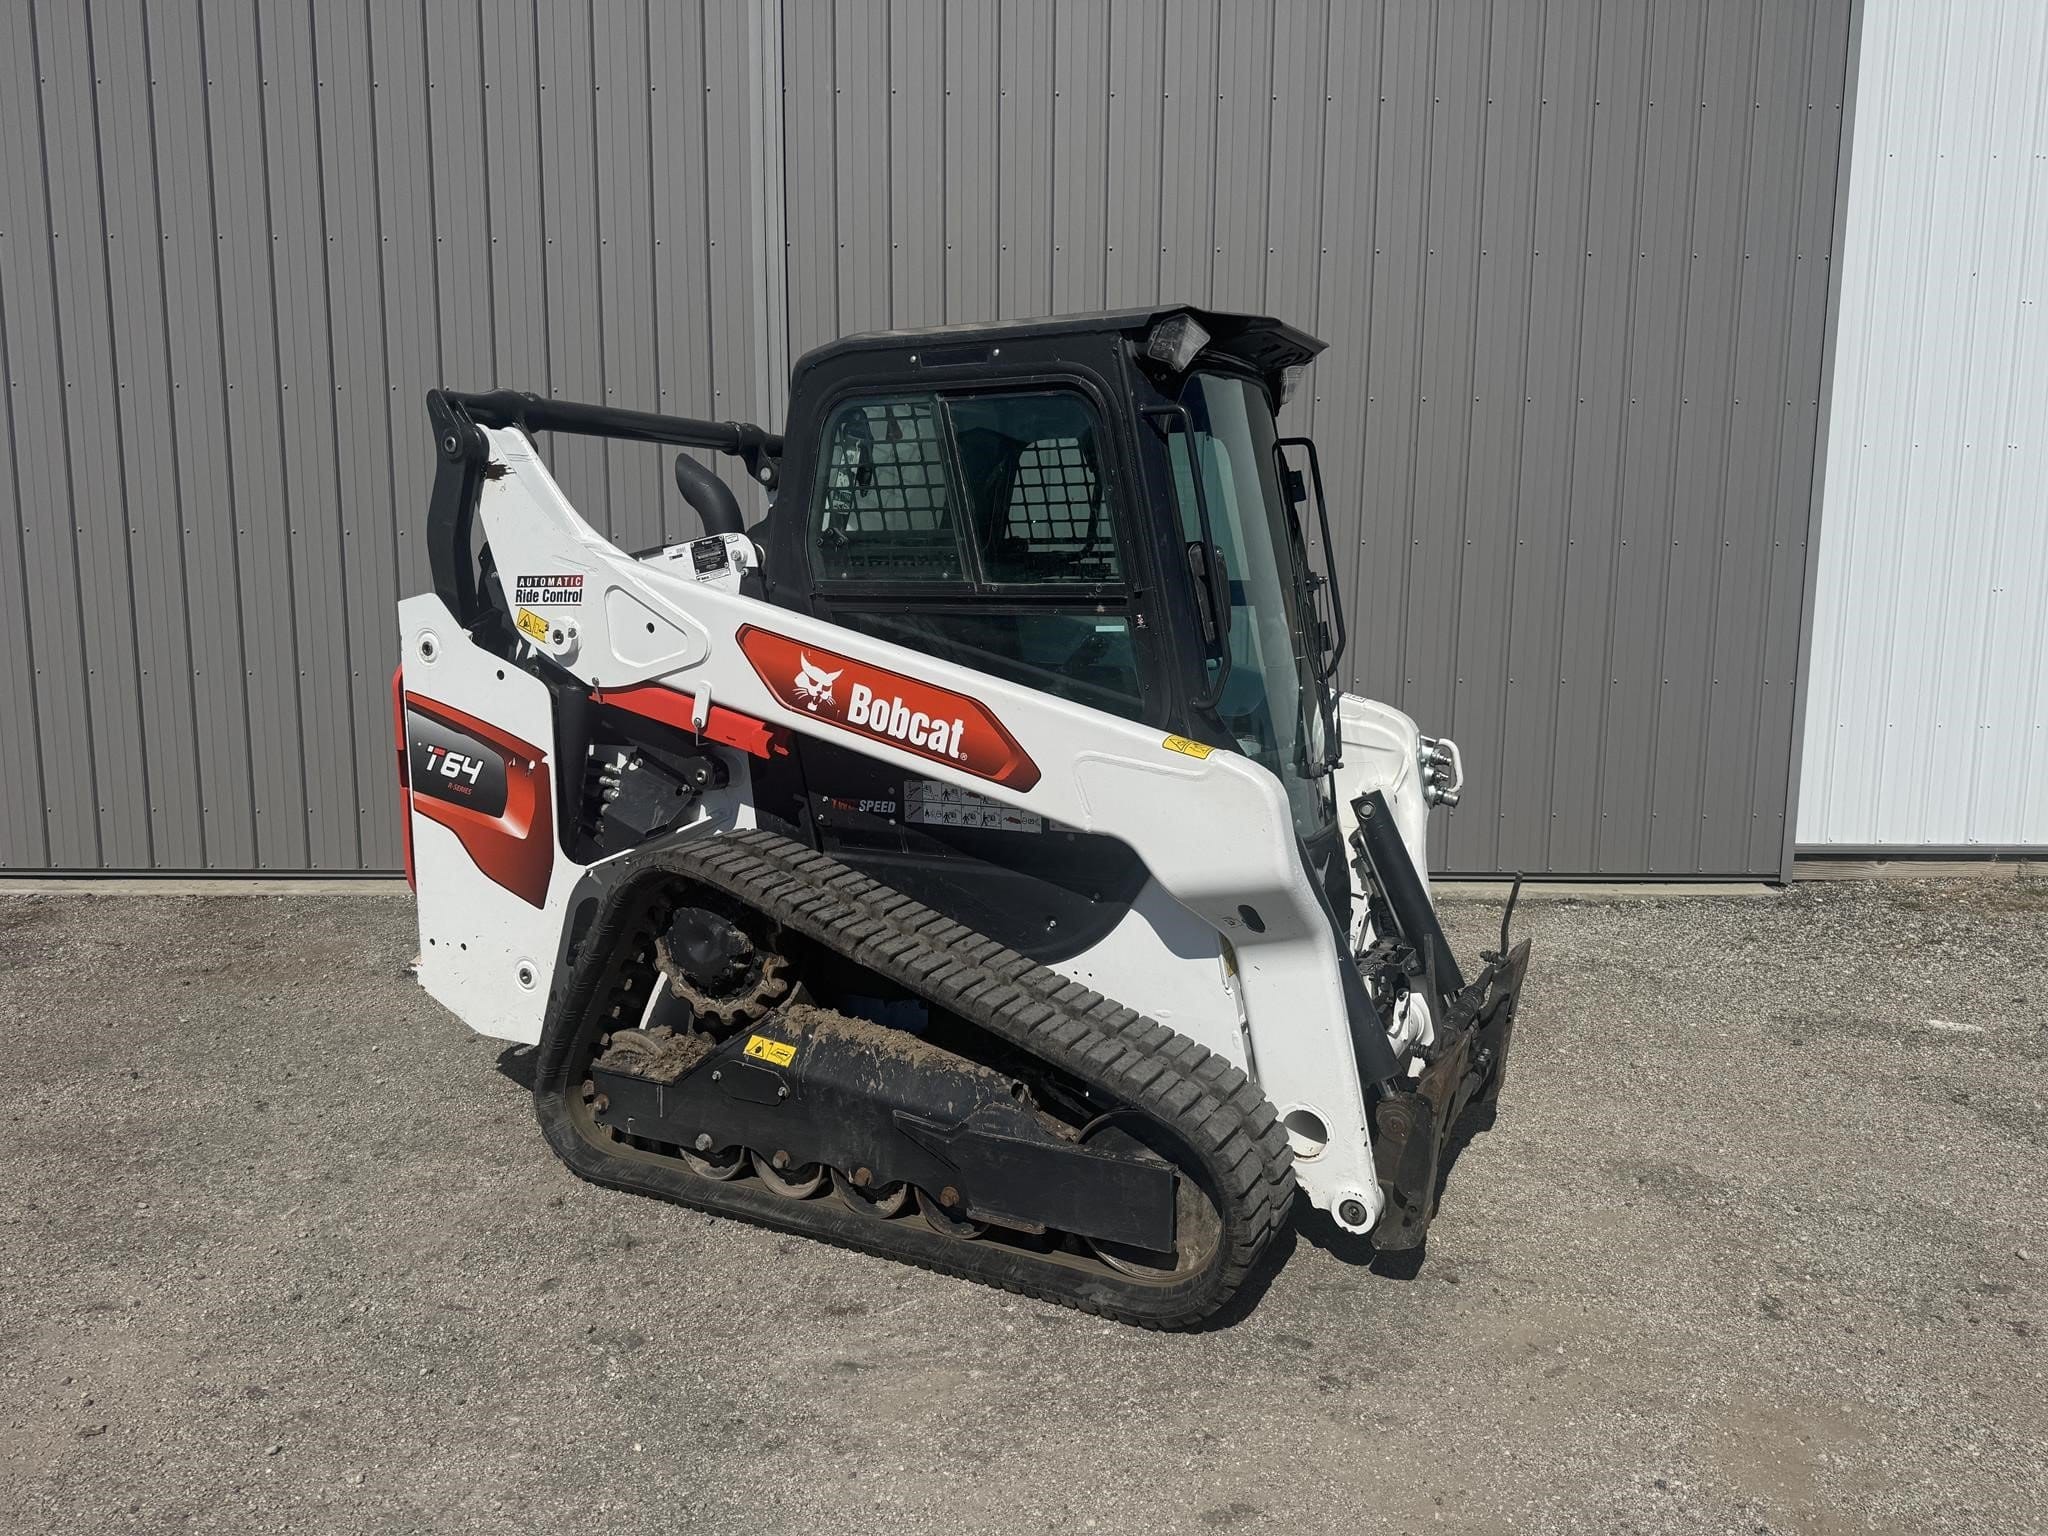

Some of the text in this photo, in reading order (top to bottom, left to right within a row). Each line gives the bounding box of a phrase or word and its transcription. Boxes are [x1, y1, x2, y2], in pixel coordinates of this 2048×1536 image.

[519, 576, 582, 587] AUTOMATIC
[515, 588, 583, 603] Ride Control
[847, 682, 964, 759] Bobcat
[426, 745, 484, 785] T64
[859, 799, 896, 814] SPEED
